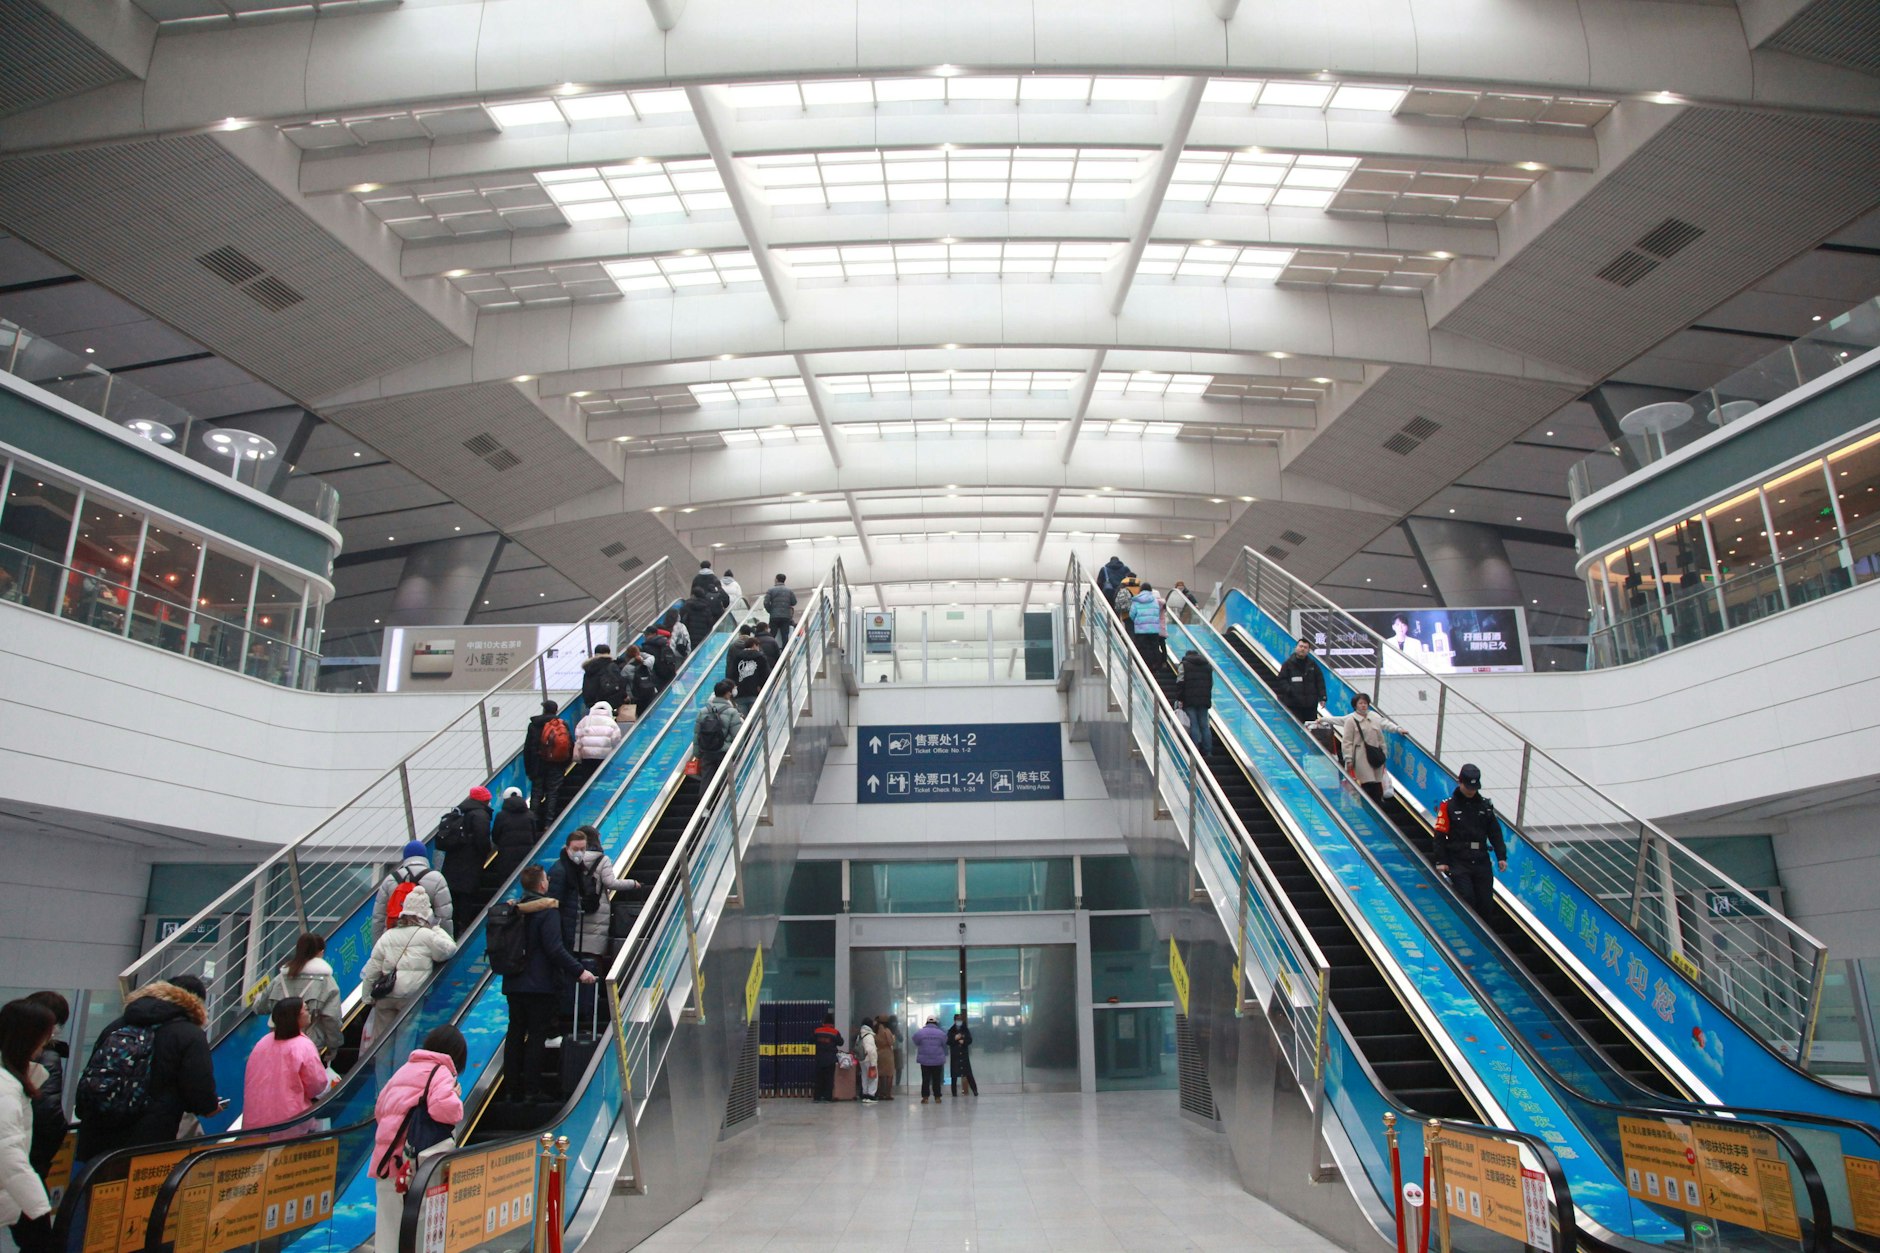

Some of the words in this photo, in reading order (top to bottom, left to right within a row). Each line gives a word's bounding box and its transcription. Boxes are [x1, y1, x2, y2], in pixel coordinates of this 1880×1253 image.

[1470, 641, 1508, 650] 期待已久
[466, 653, 509, 666] 小罐茶
[914, 732, 976, 746] 售票处1-2
[914, 772, 984, 786] 检票口1-24
[1016, 771, 1051, 783] 候车区
[1520, 857, 1677, 1024] 北京南站欢迎您
[1698, 1138, 1749, 1158] 请您扶好扶手带
